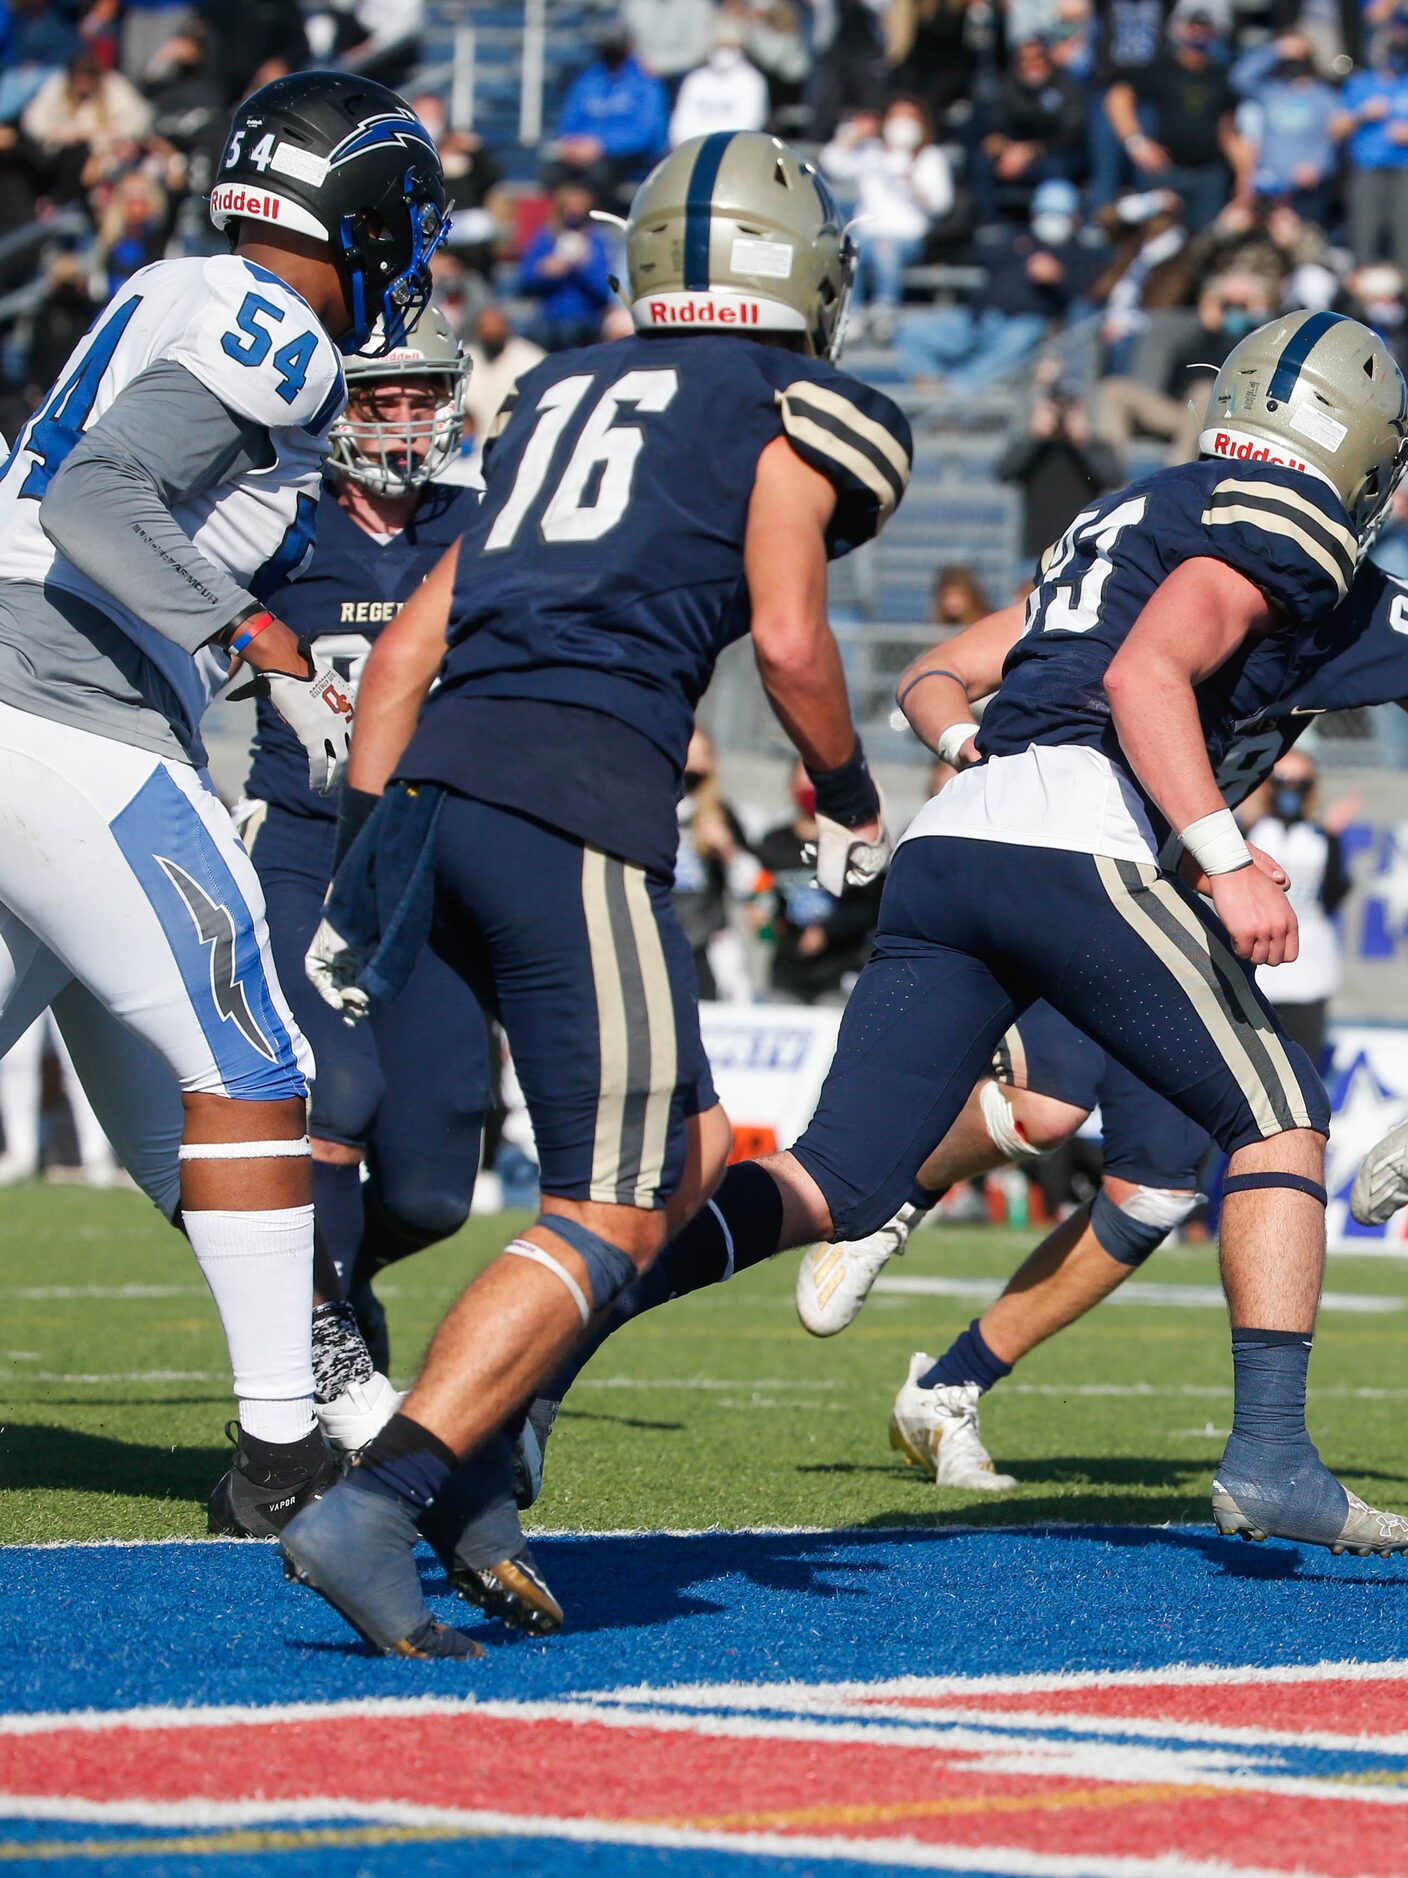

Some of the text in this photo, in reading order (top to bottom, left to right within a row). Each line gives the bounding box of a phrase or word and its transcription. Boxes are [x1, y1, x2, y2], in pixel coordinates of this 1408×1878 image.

[225, 130, 276, 172] 54
[211, 189, 280, 219] Riddell
[649, 301, 770, 324] Riddell
[220, 291, 319, 406] 54
[480, 367, 682, 552] 16
[269, 1496, 296, 1512] VAPOR
